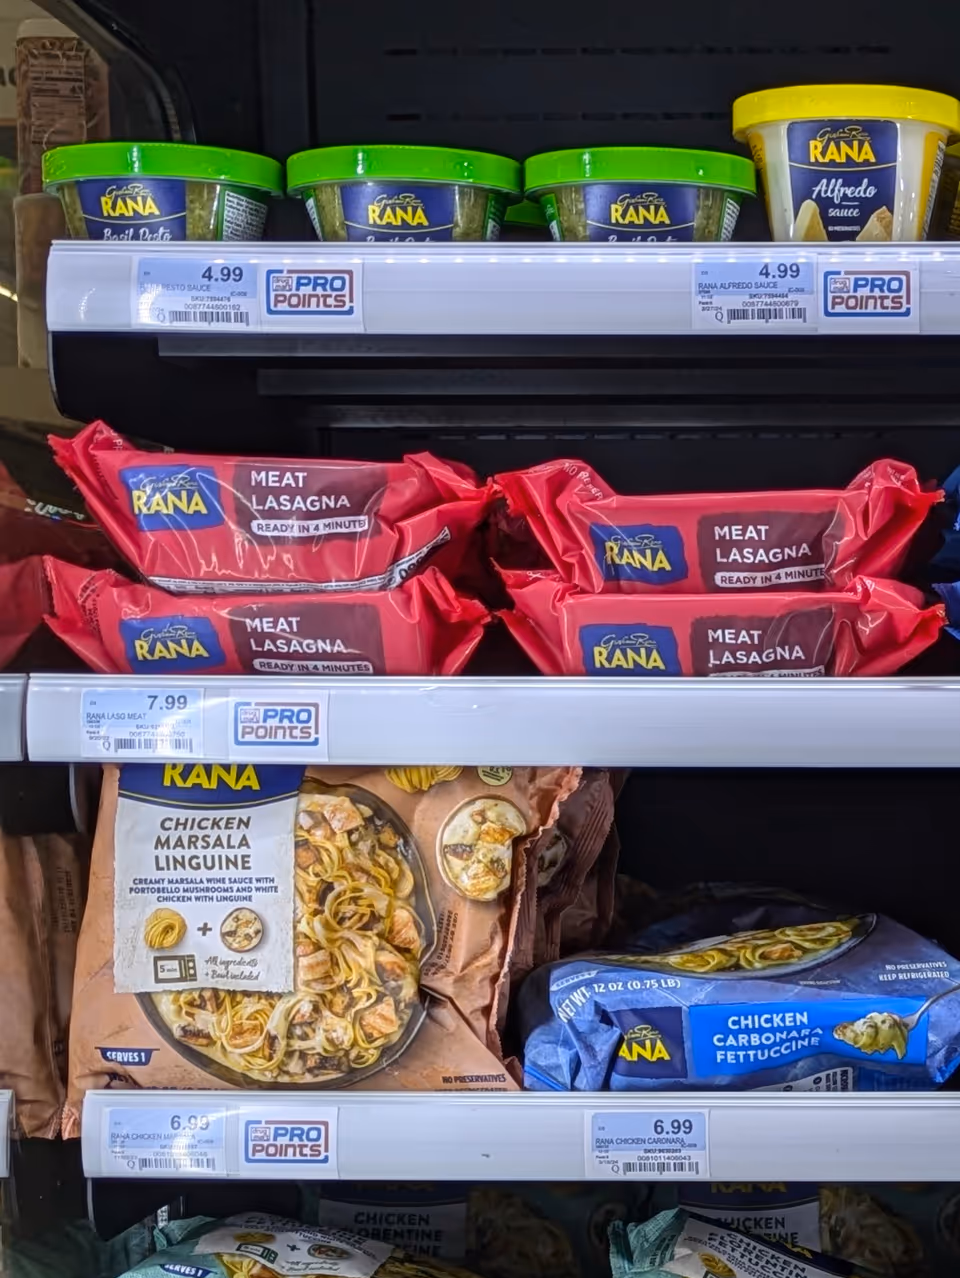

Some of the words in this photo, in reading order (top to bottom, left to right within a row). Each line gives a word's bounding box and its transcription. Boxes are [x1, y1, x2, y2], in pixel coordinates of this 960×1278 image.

[809, 140, 875, 163] RANA
[812, 178, 877, 203] Alfredo
[101, 196, 160, 216] RANA
[828, 208, 860, 217] sauce
[368, 205, 429, 226] RANA
[611, 204, 670, 225] RANA
[202, 267, 243, 283] 4.99
[759, 264, 800, 278] 4.99
[295, 276, 346, 292] PRO
[273, 293, 346, 308] POINTS
[250, 471, 308, 488] MEAT
[132, 488, 207, 516] RANA
[250, 494, 350, 511] LASAGNA
[245, 617, 300, 633] MEAT
[134, 639, 209, 661] RANA
[250, 637, 347, 653] LASAGNA
[259, 661, 294, 671] READY
[298, 662, 309, 671] IN
[311, 664, 320, 672] 4
[323, 662, 370, 673] MINUTES
[147, 696, 188, 711] 7.99
[163, 763, 260, 791] RANA
[160, 816, 251, 831] CHICKEN
[154, 835, 251, 850] MARSALA
[155, 854, 251, 870] LINGUINE
[132, 877, 165, 885] CREAMY
[167, 877, 203, 885] MARSALA
[206, 877, 224, 885] WINE
[227, 877, 251, 885] SAUCE
[254, 877, 275, 885] WITH
[727, 1012, 809, 1030] CHICKEN
[713, 1027, 823, 1047] CARBONARA
[107, 1050, 137, 1062] SERVES
[140, 1051, 145, 1062] 1
[716, 1036, 819, 1064] FETTUCCINE
[653, 1119, 693, 1136] 6.99
